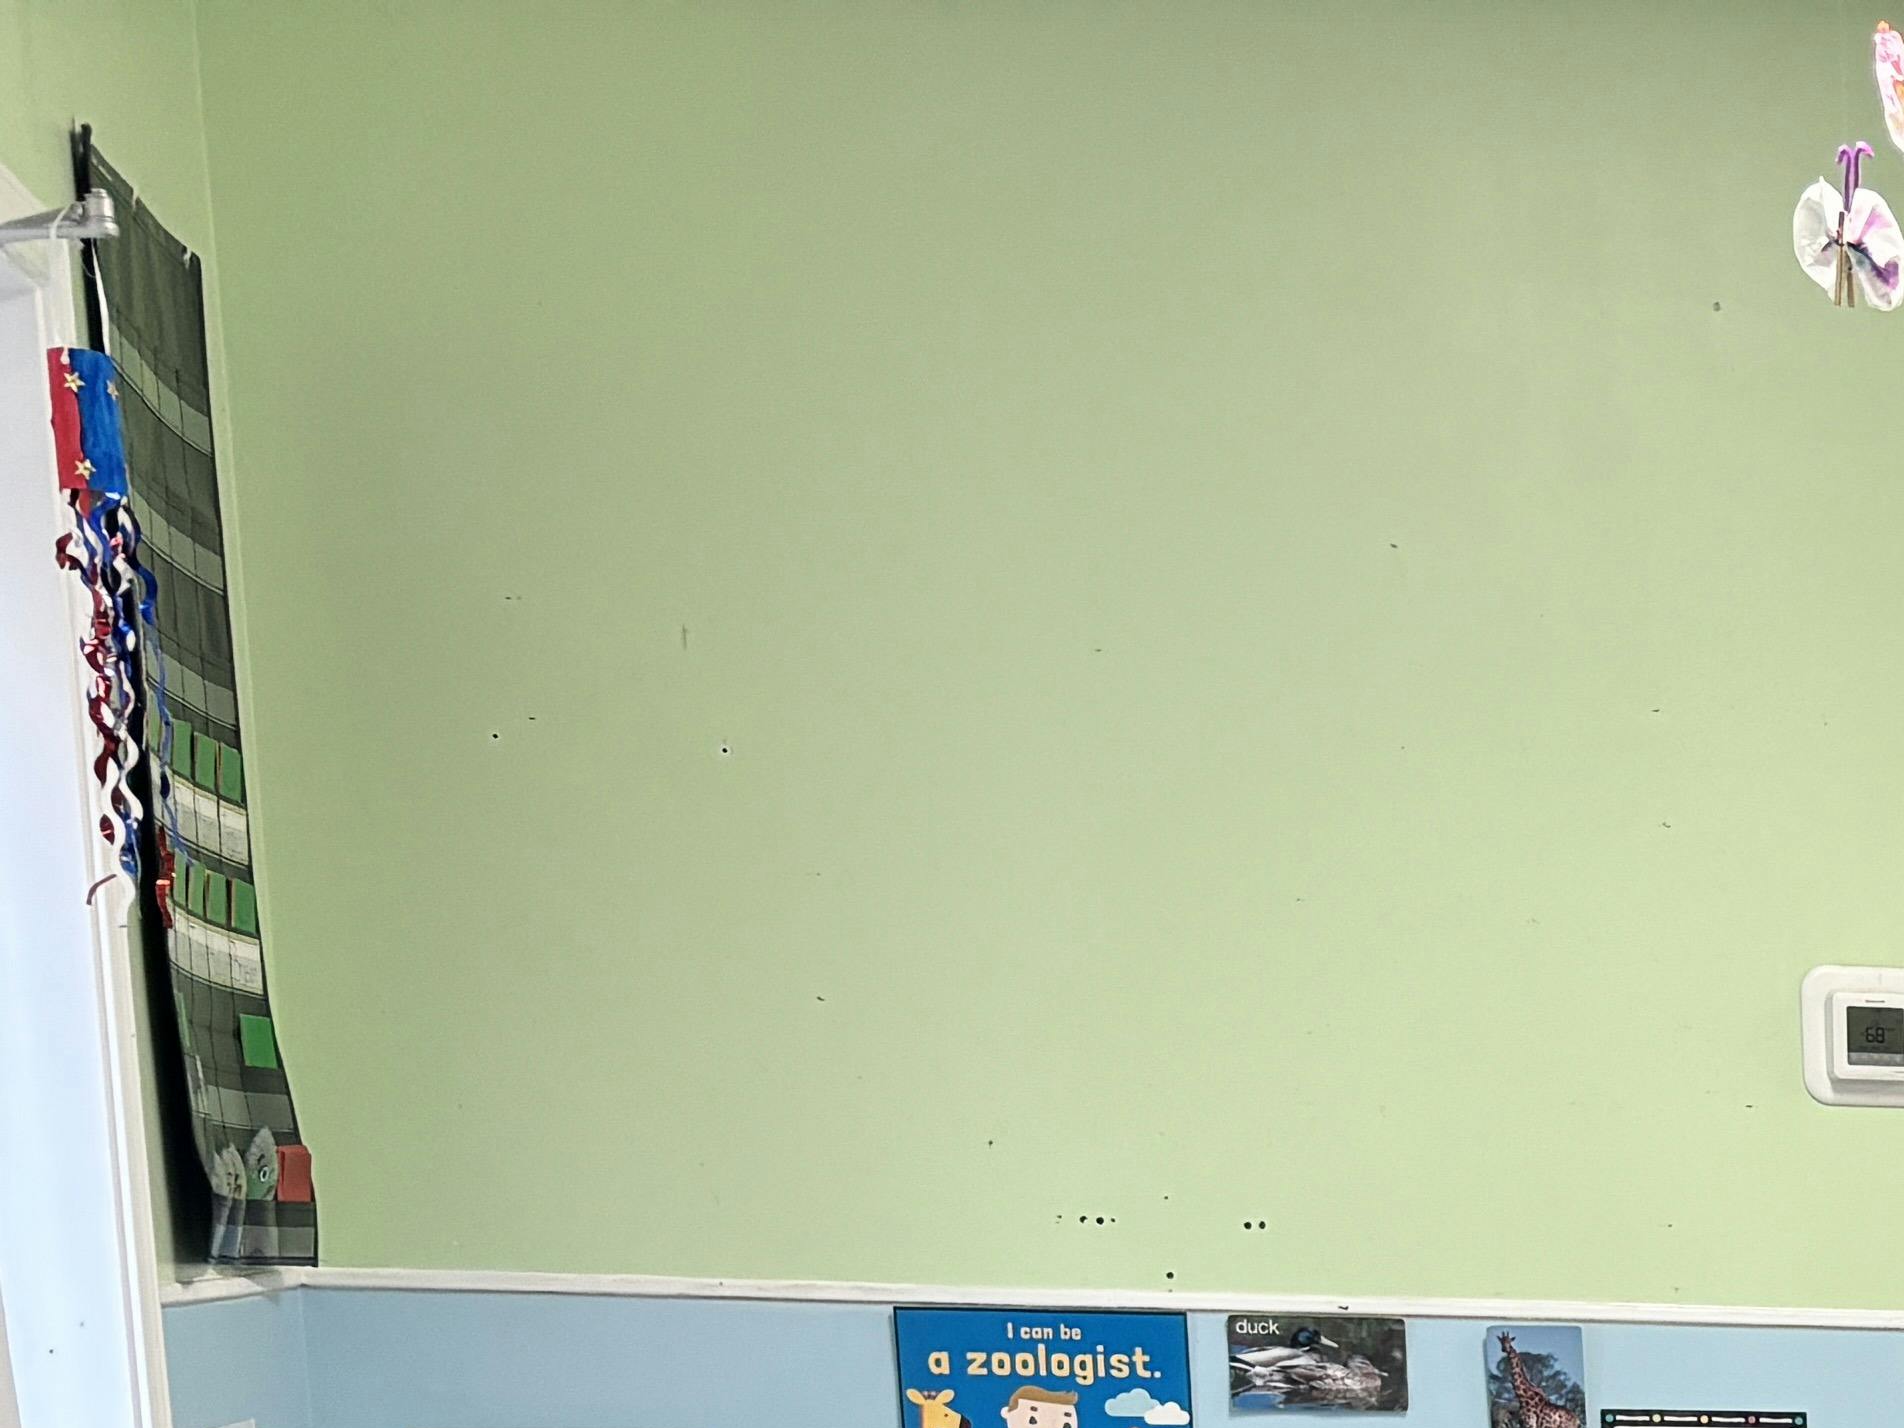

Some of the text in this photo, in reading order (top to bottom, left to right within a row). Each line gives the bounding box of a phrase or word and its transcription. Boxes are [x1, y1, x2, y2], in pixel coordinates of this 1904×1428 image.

[1006, 1322, 1082, 1340] I can be
[1235, 1318, 1280, 1336] duck
[928, 1344, 1162, 1385] a zoologist.
